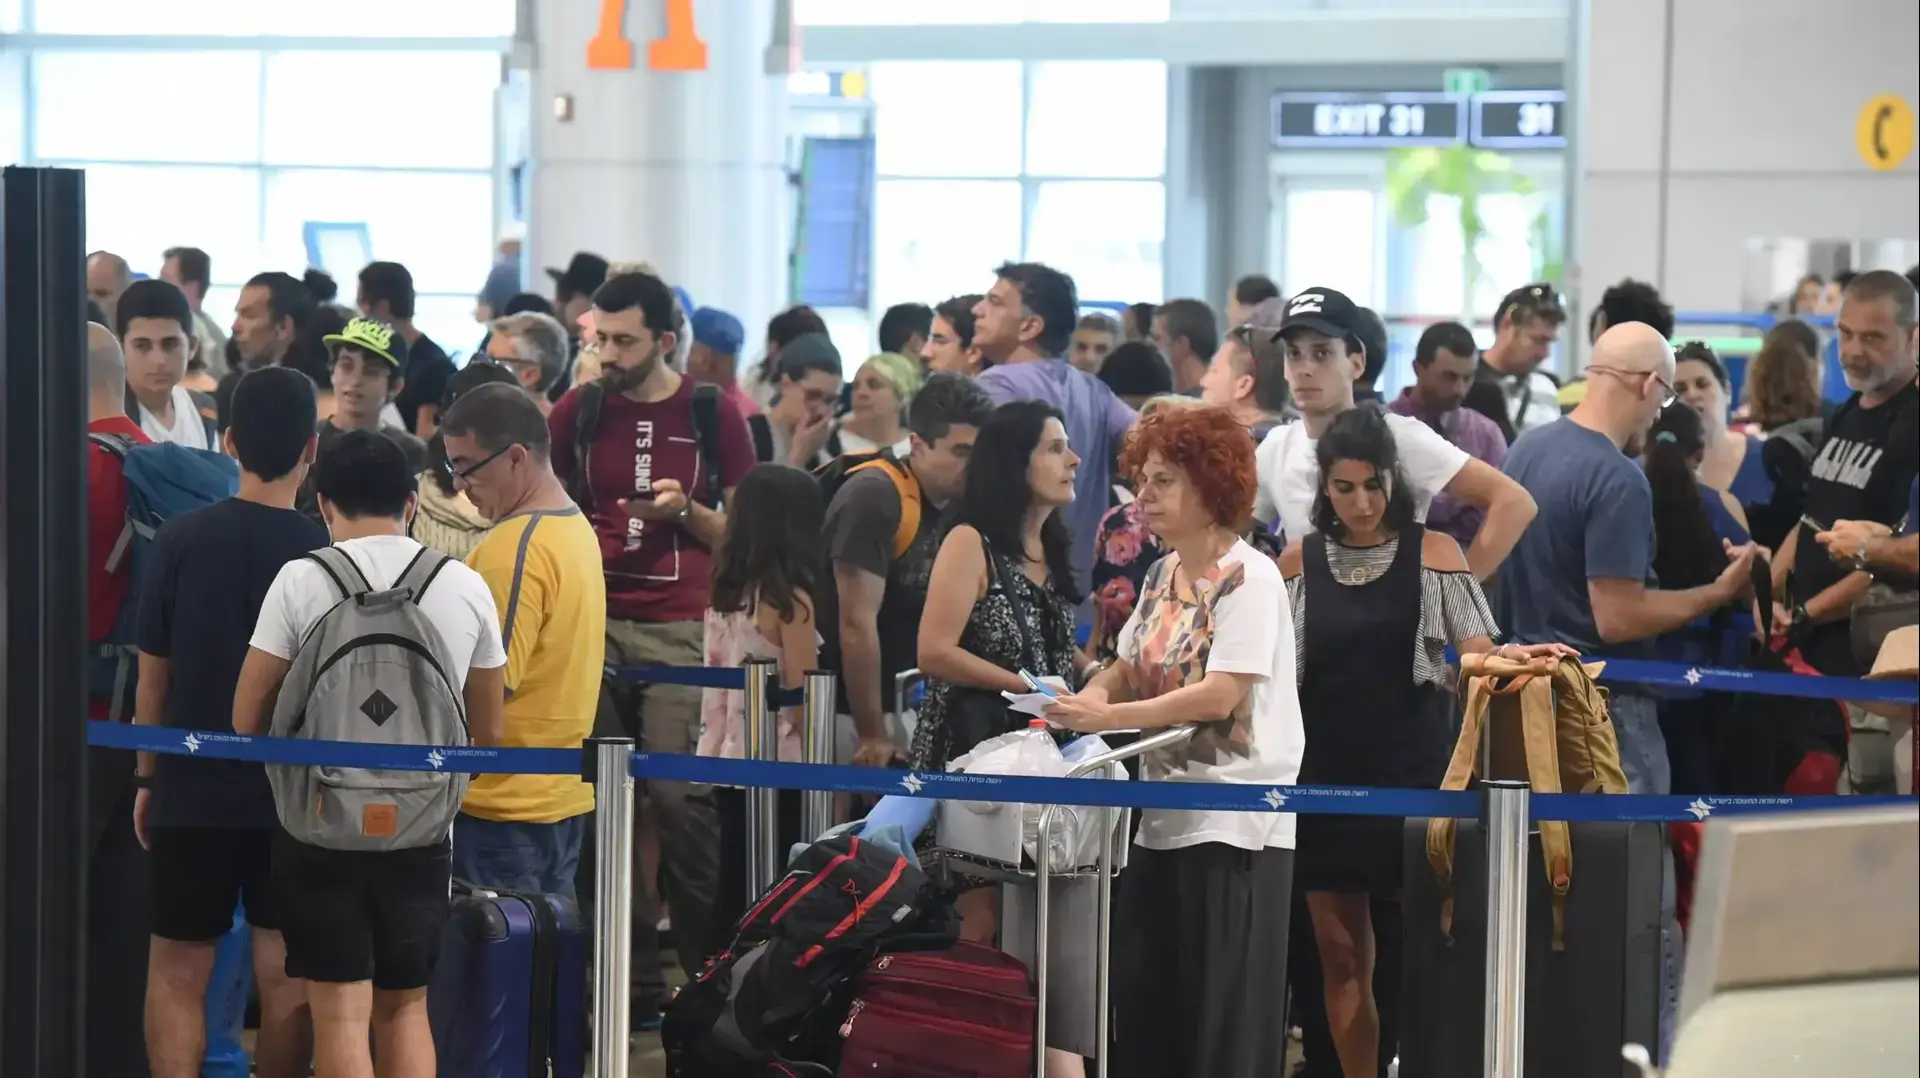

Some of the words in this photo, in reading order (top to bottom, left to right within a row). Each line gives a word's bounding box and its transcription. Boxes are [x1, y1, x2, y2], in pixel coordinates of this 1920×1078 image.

[1314, 103, 1385, 136] EXIT
[1388, 103, 1425, 136] 31
[1517, 102, 1554, 136] 31
[636, 420, 654, 449] IT'S
[634, 453, 653, 493] SUND
